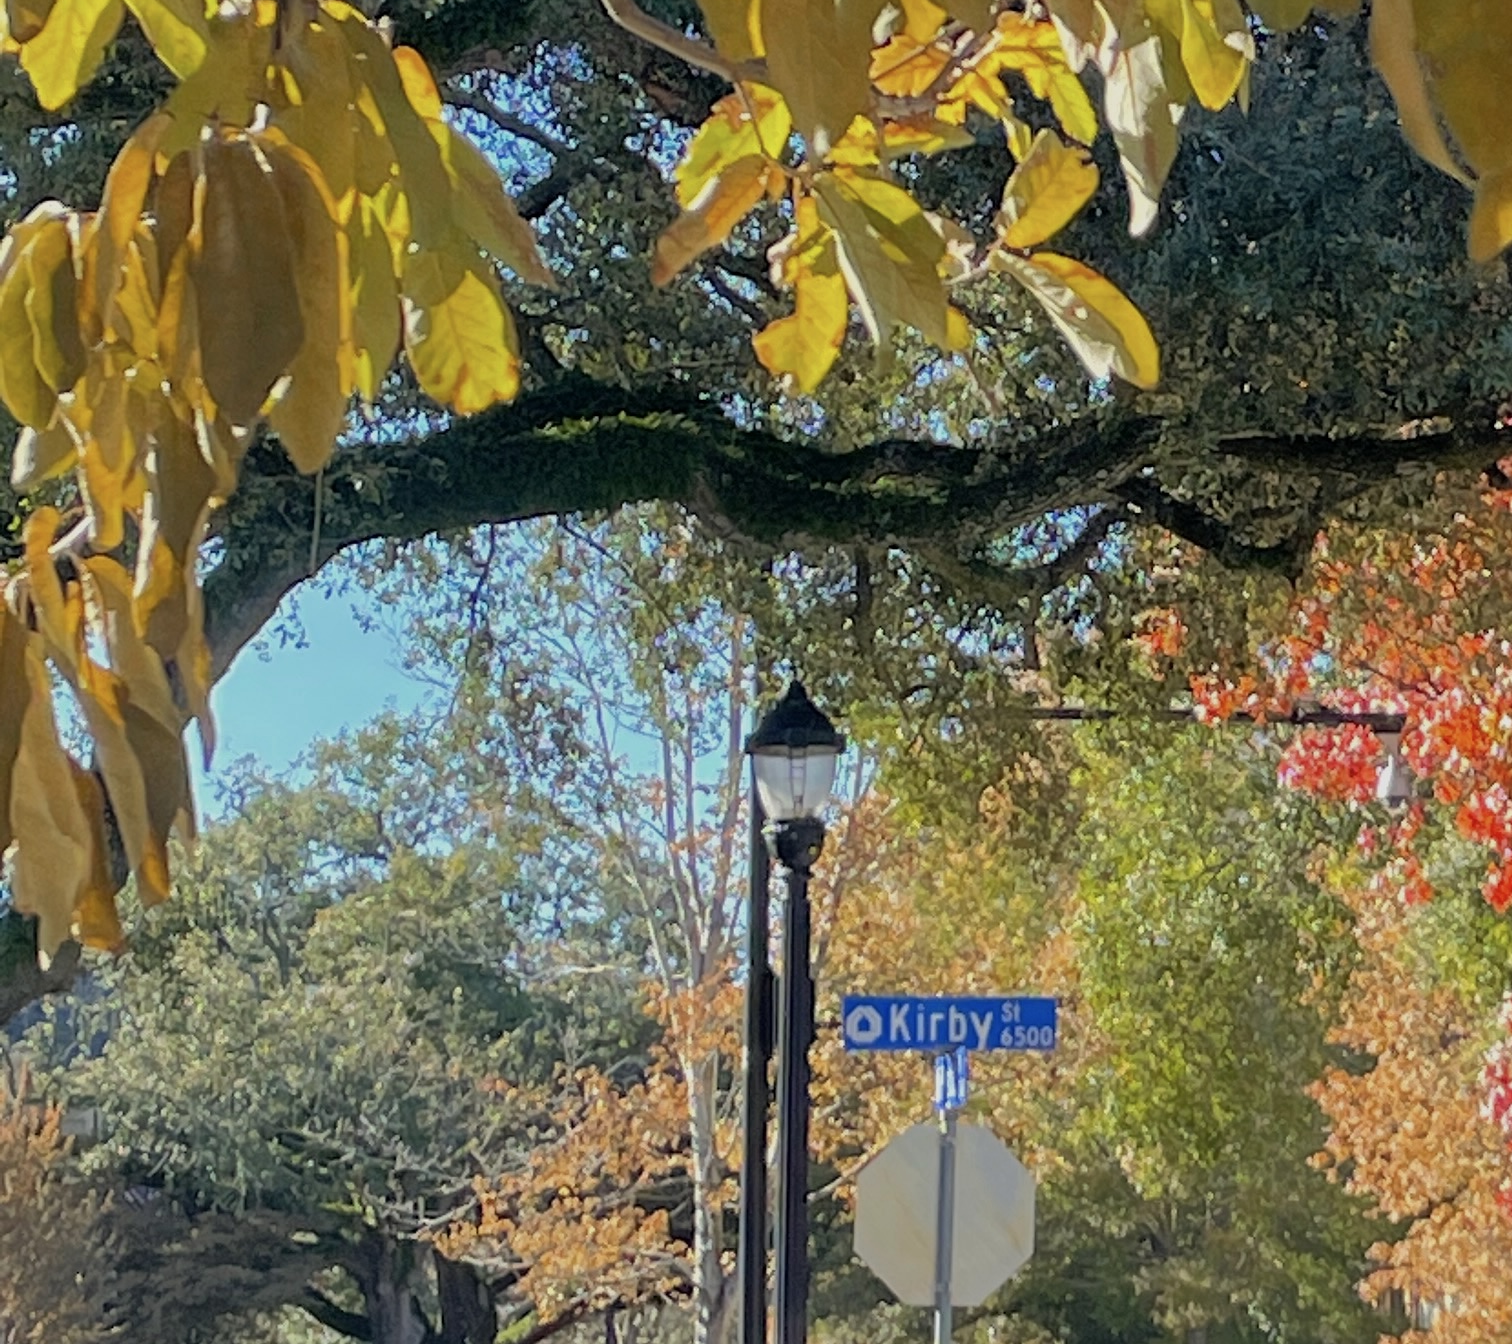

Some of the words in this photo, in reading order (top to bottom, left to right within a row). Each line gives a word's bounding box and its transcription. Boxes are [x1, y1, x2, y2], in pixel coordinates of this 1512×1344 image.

[889, 1003, 994, 1049] Kirby
[1001, 1000, 1021, 1023] St
[1001, 1026, 1053, 1047] 6500
